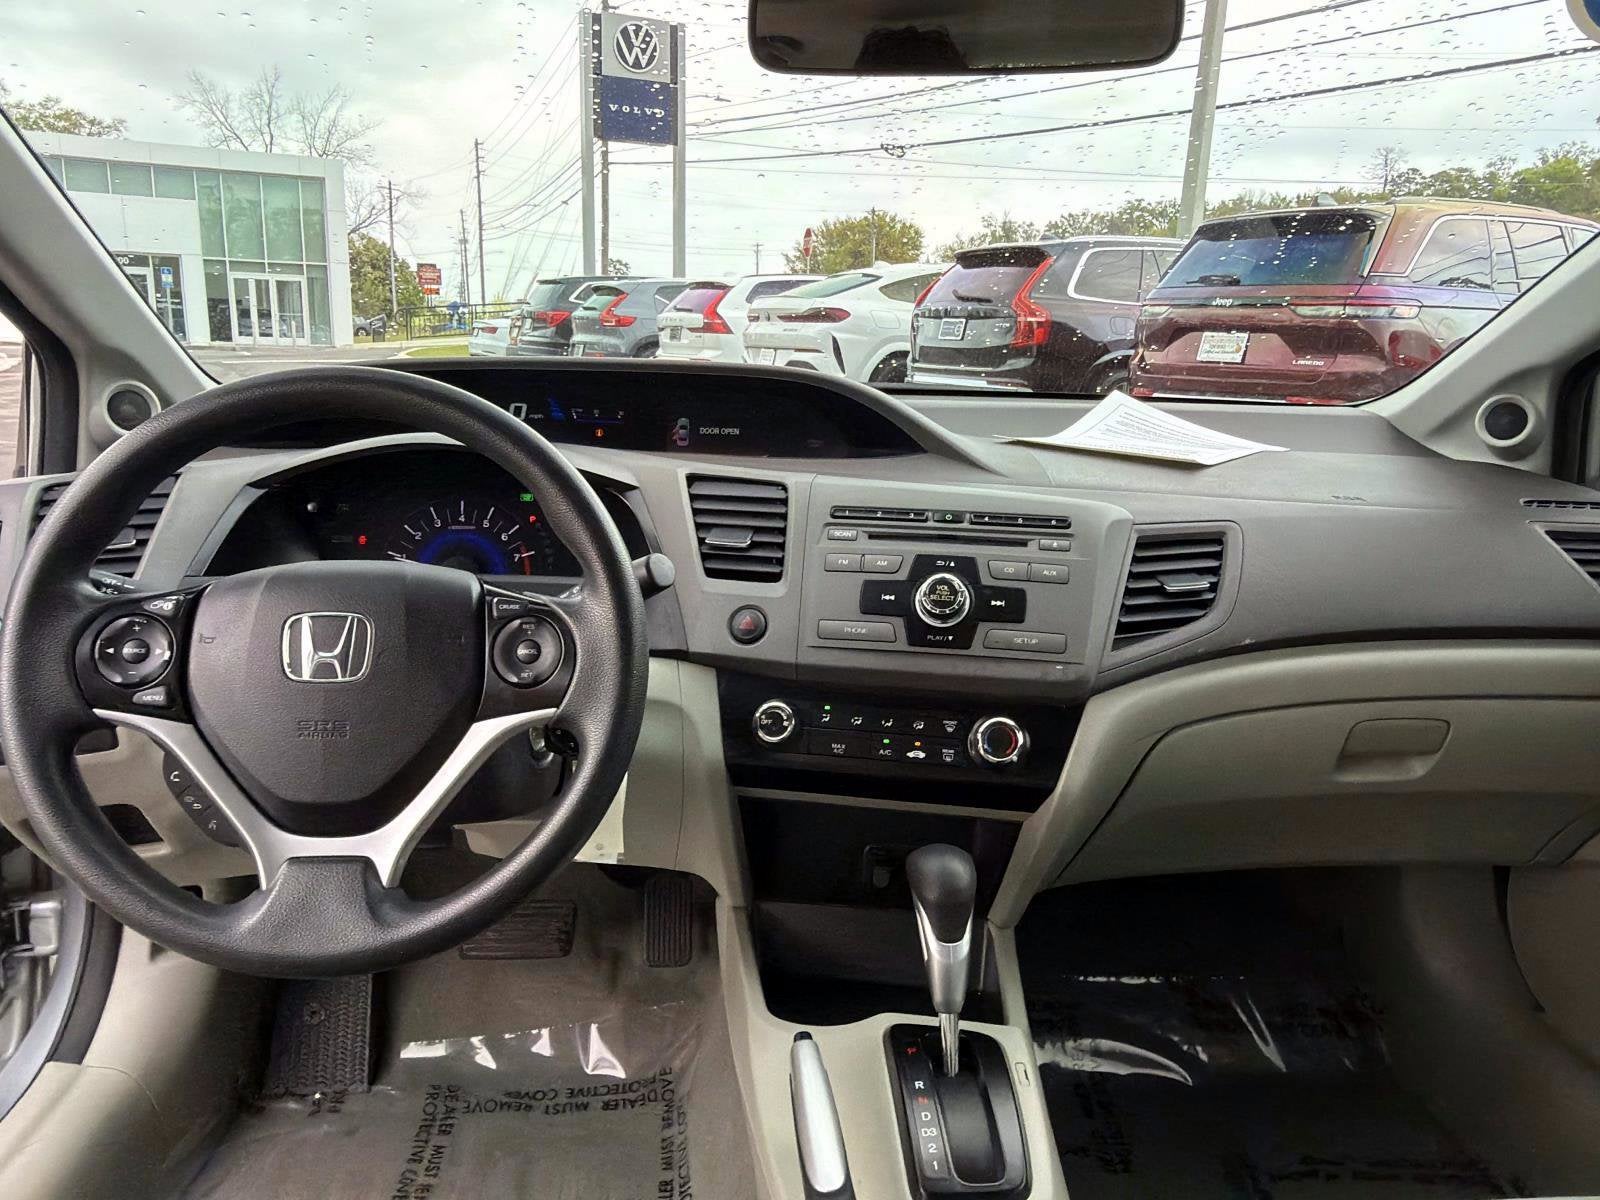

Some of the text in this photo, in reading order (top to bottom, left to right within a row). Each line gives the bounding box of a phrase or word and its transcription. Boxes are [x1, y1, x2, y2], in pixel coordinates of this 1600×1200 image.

[608, 103, 665, 118] VOLVO
[1212, 297, 1233, 307] Jeep
[699, 427, 740, 435] DOOR OPEN
[458, 514, 465, 522] 4
[434, 519, 442, 528] 3
[482, 519, 490, 528] 5
[414, 531, 423, 540] 2
[501, 532, 508, 541] 6
[513, 553, 521, 562] 7
[915, 1081, 924, 1089] R
[545, 1101, 590, 1114] MUST
[922, 1112, 931, 1120] D
[922, 1128, 937, 1136] D3
[928, 1144, 937, 1153] 2
[933, 1161, 938, 1170] 1
